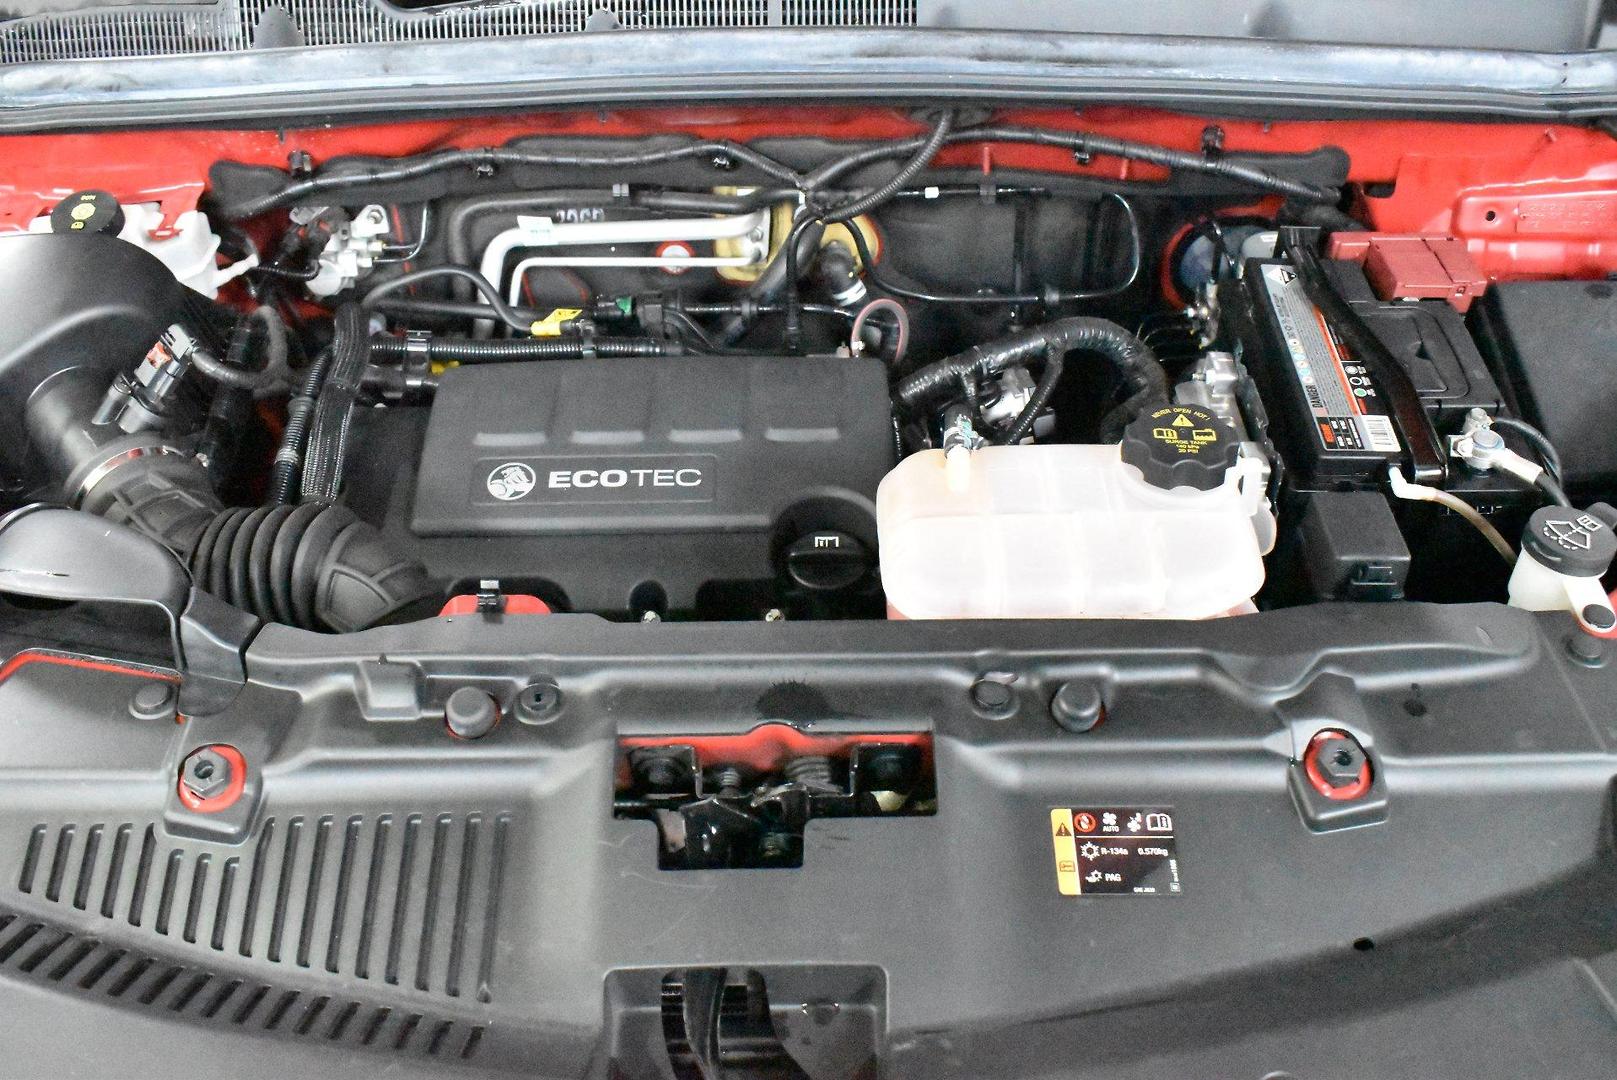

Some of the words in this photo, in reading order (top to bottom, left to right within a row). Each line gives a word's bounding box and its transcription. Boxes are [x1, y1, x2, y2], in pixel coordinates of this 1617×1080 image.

[1151, 408, 1172, 419] NEVER
[548, 468, 702, 488] ECOTEC
[1100, 847, 1129, 856] R-134a
[1137, 847, 1169, 857] 0.570kg
[1104, 873, 1122, 881] PAG
